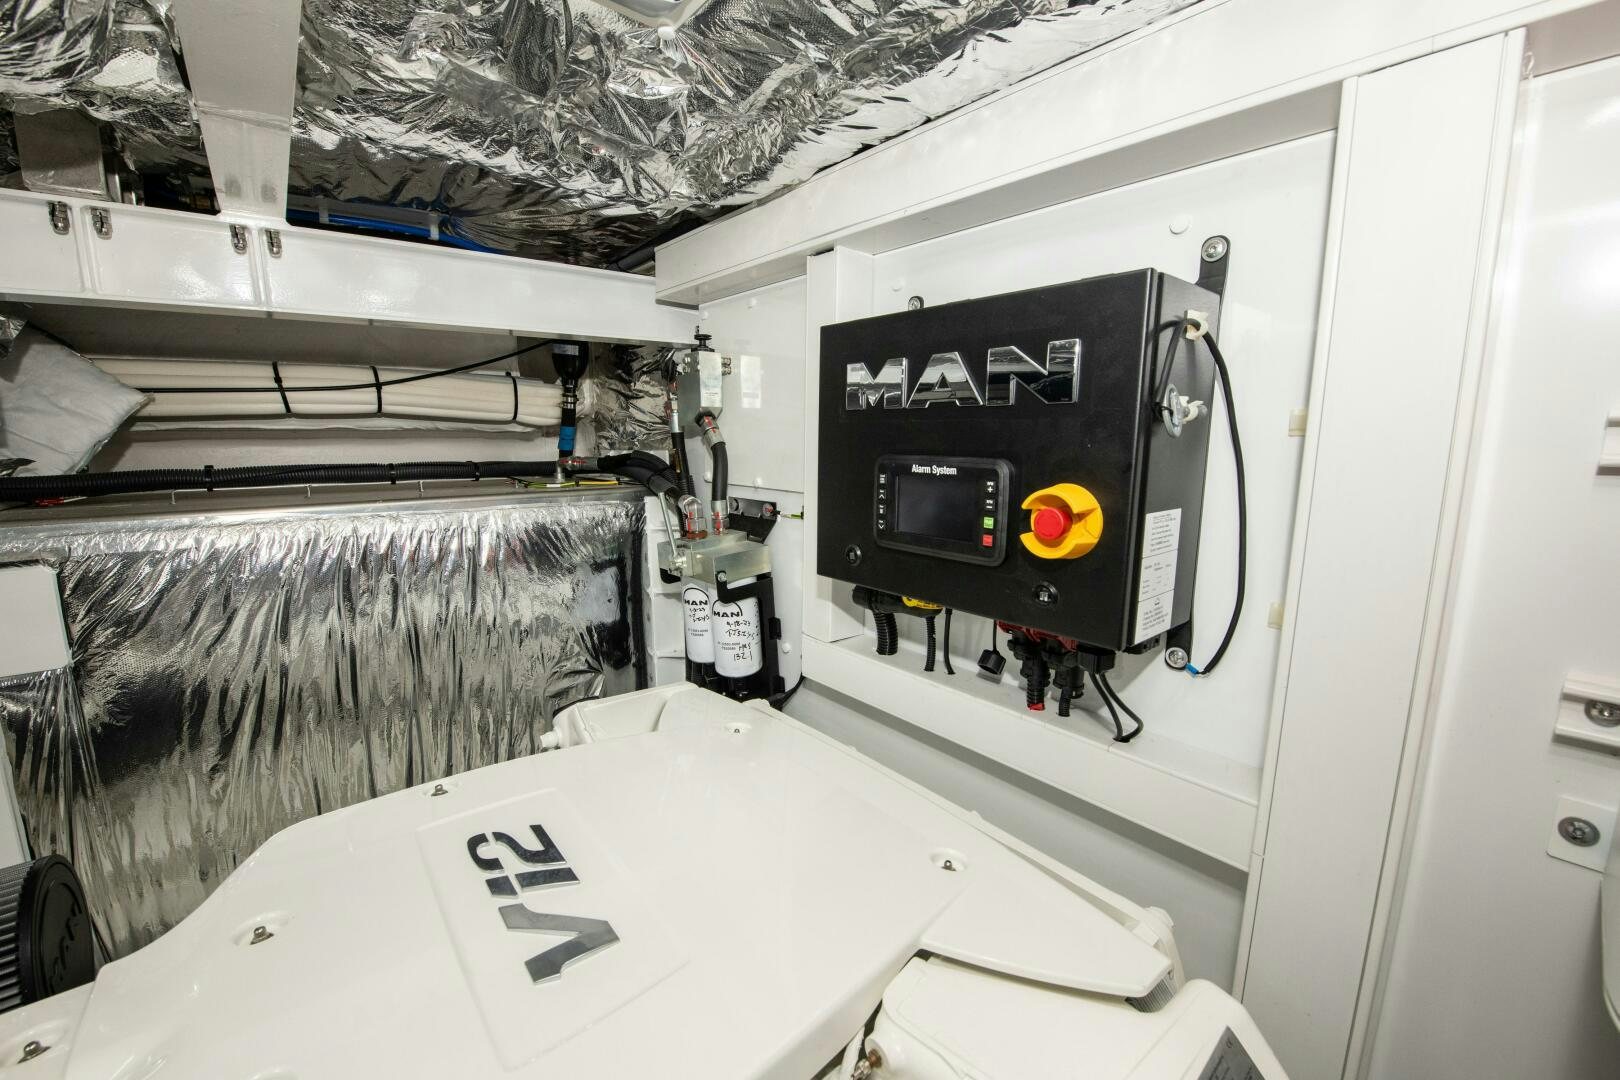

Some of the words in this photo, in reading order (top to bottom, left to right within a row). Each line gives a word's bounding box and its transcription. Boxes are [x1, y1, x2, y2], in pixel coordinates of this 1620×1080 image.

[846, 338, 1081, 411] MAN
[911, 464, 931, 474] Alarm
[932, 464, 957, 476] System
